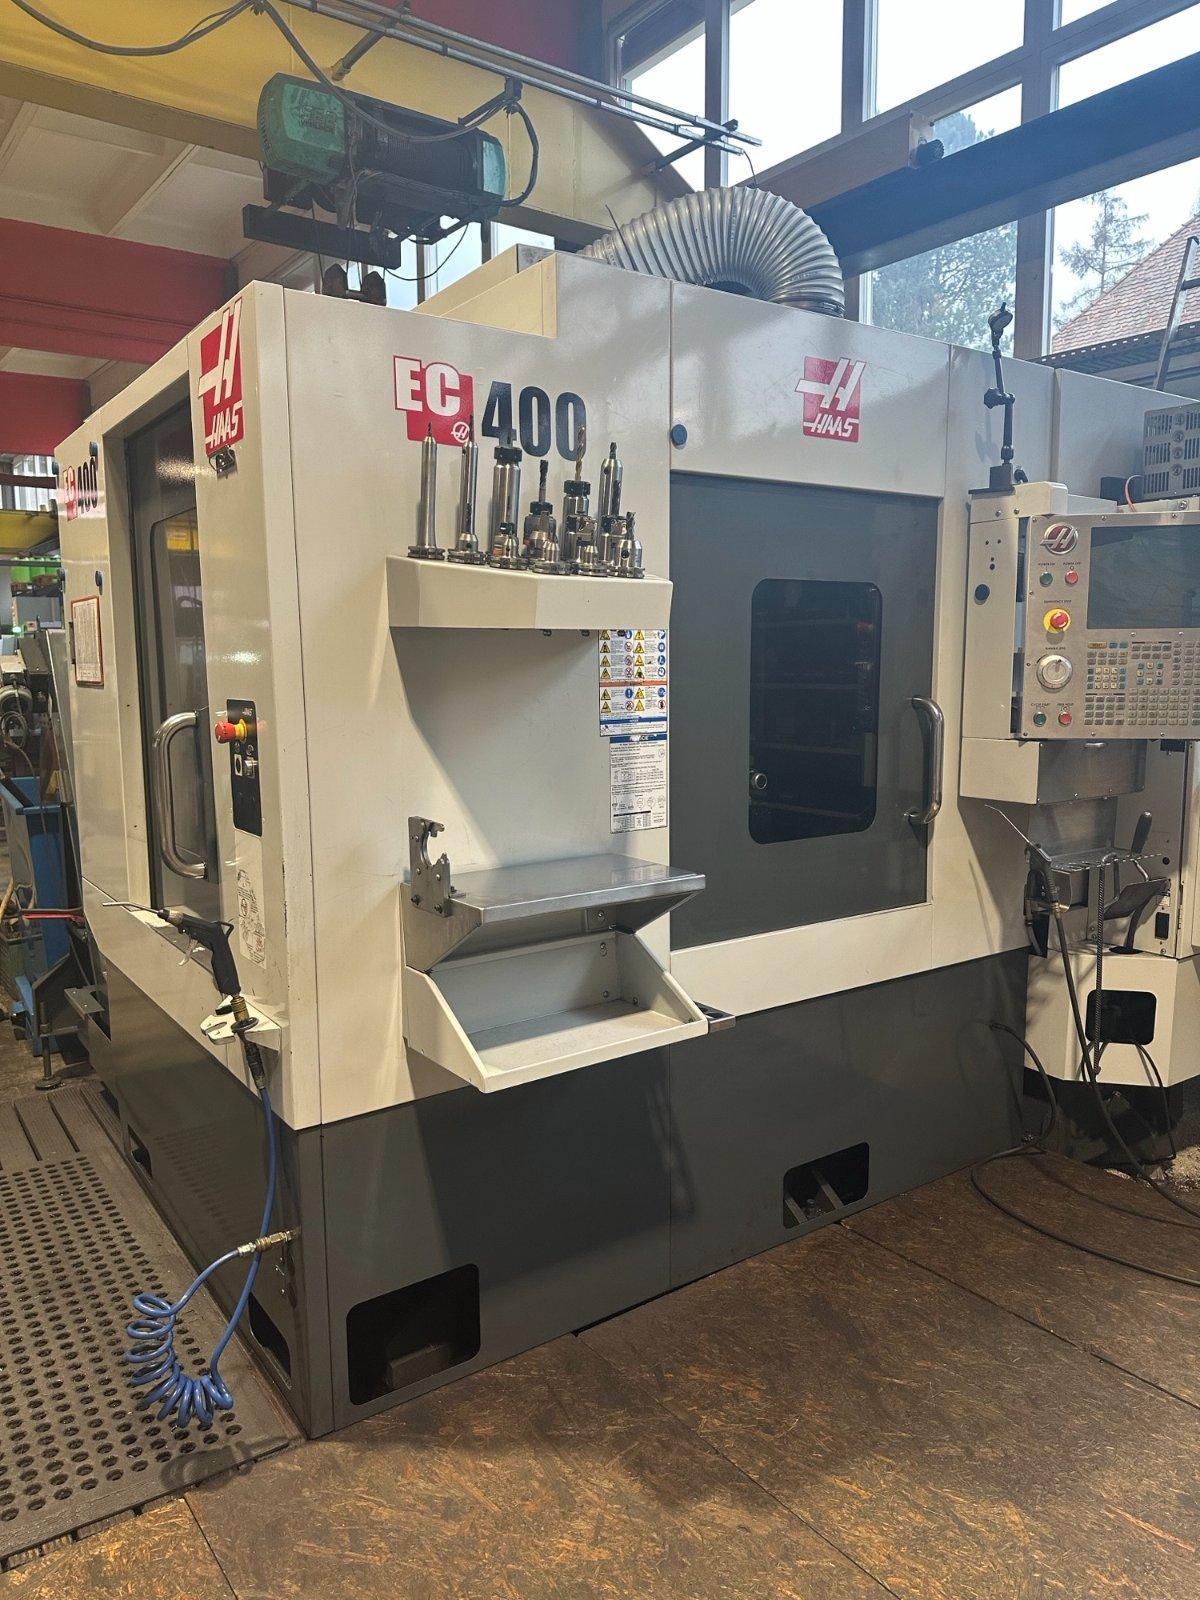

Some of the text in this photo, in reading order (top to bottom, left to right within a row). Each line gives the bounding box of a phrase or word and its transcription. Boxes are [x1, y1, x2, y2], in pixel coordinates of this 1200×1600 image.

[205, 399, 243, 449] HAAS
[393, 355, 587, 461] EC 400
[803, 413, 860, 437] HAAS
[77, 456, 98, 513] 400
